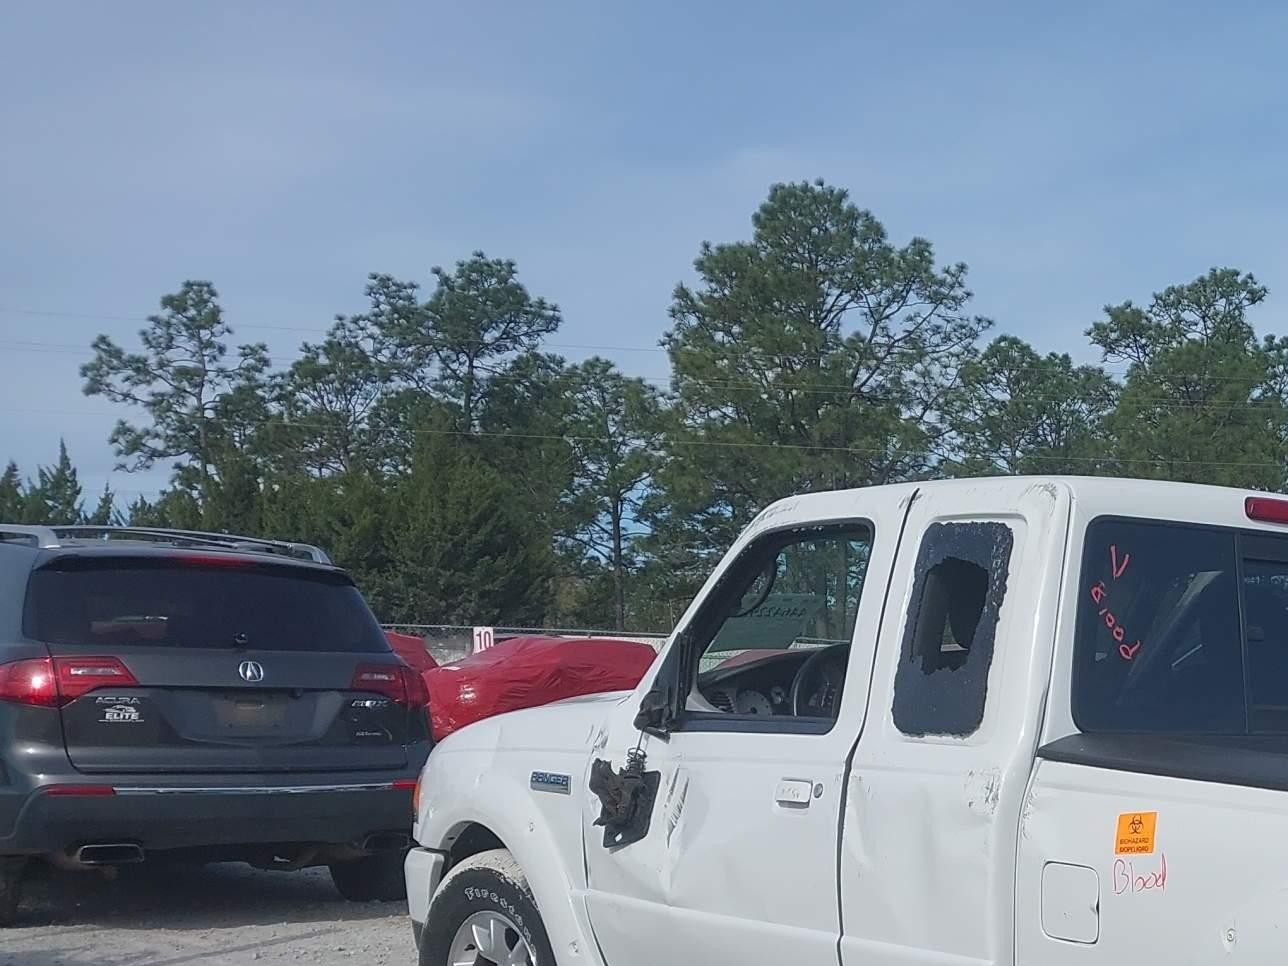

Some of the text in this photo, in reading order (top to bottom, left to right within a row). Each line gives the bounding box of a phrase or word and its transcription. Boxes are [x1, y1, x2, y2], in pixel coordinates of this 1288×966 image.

[475, 630, 491, 650] 10
[105, 712, 140, 720] ELITE
[531, 772, 570, 786] RANGER
[1113, 852, 1167, 895] Blood
